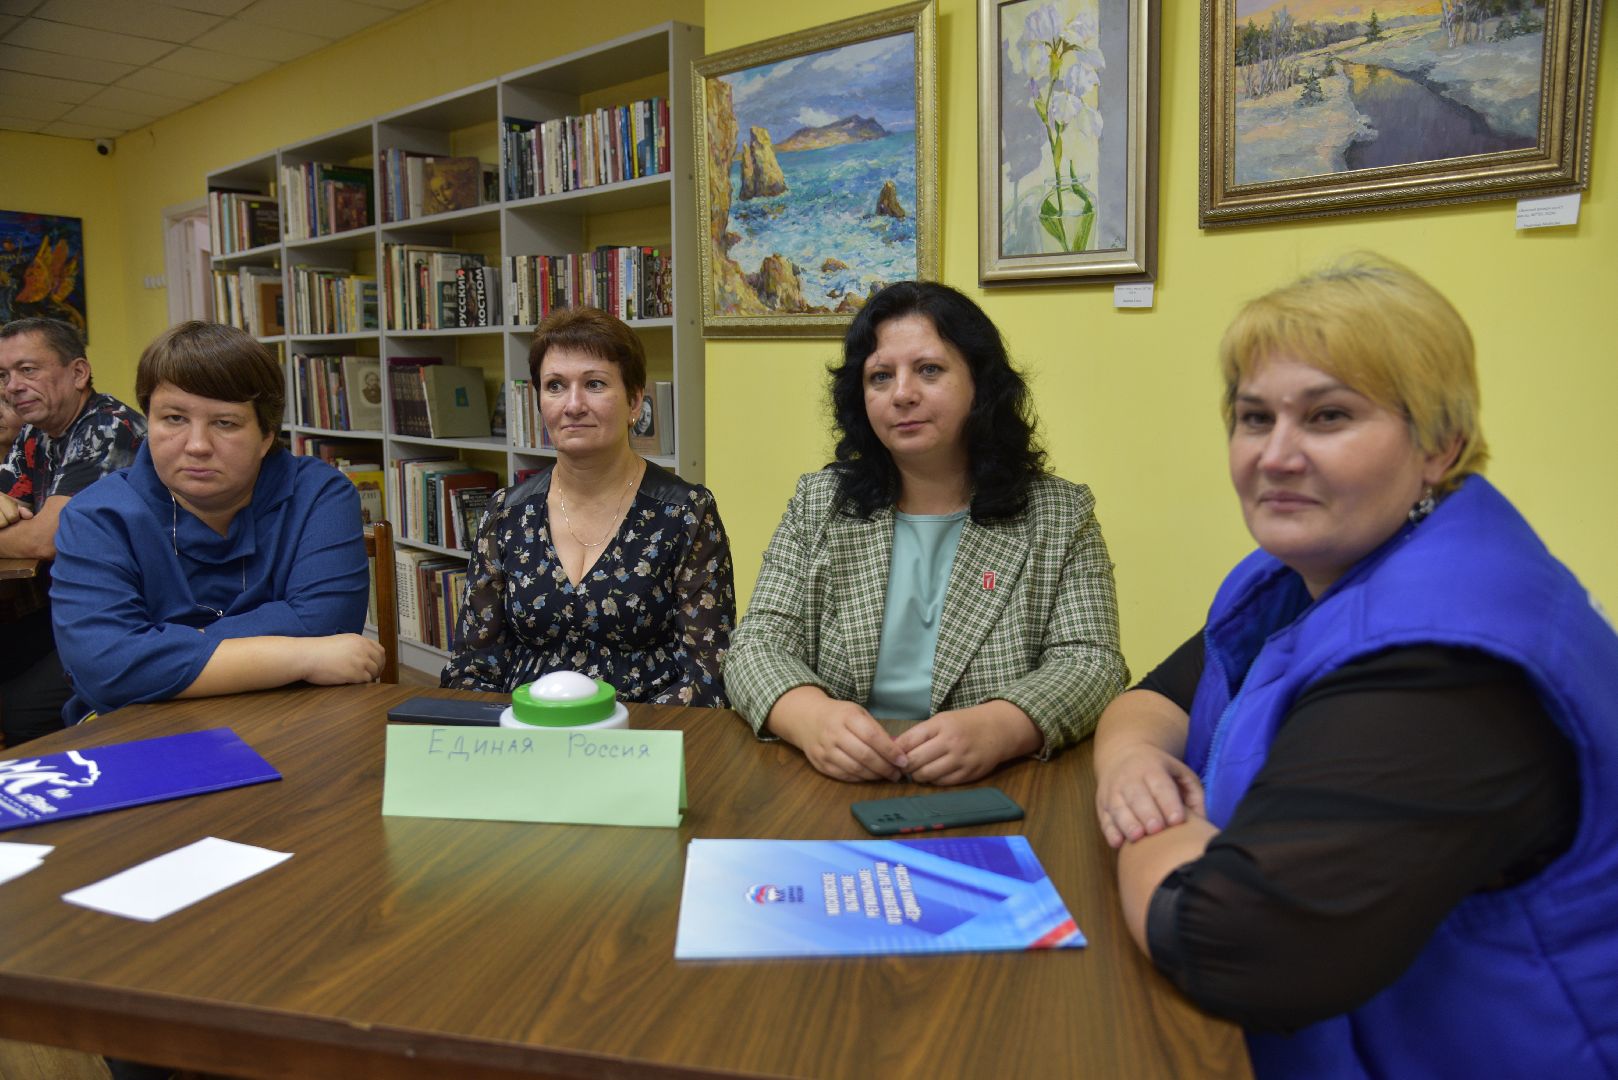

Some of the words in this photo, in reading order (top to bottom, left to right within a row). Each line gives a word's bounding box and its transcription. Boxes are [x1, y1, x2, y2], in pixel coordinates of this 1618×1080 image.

[476, 268, 487, 326] КОСТЮМ
[568, 732, 651, 759] Россия
[841, 875, 859, 911] ОБЛАСТНОЕ
[859, 868, 880, 916] РЕГИОНАЛЬНОЕ
[875, 862, 891, 885] ПАРТИИ
[823, 873, 840, 915] МОСКОВСКОЕ
[881, 885, 903, 924] ОТДЕЛЕНИЕ
